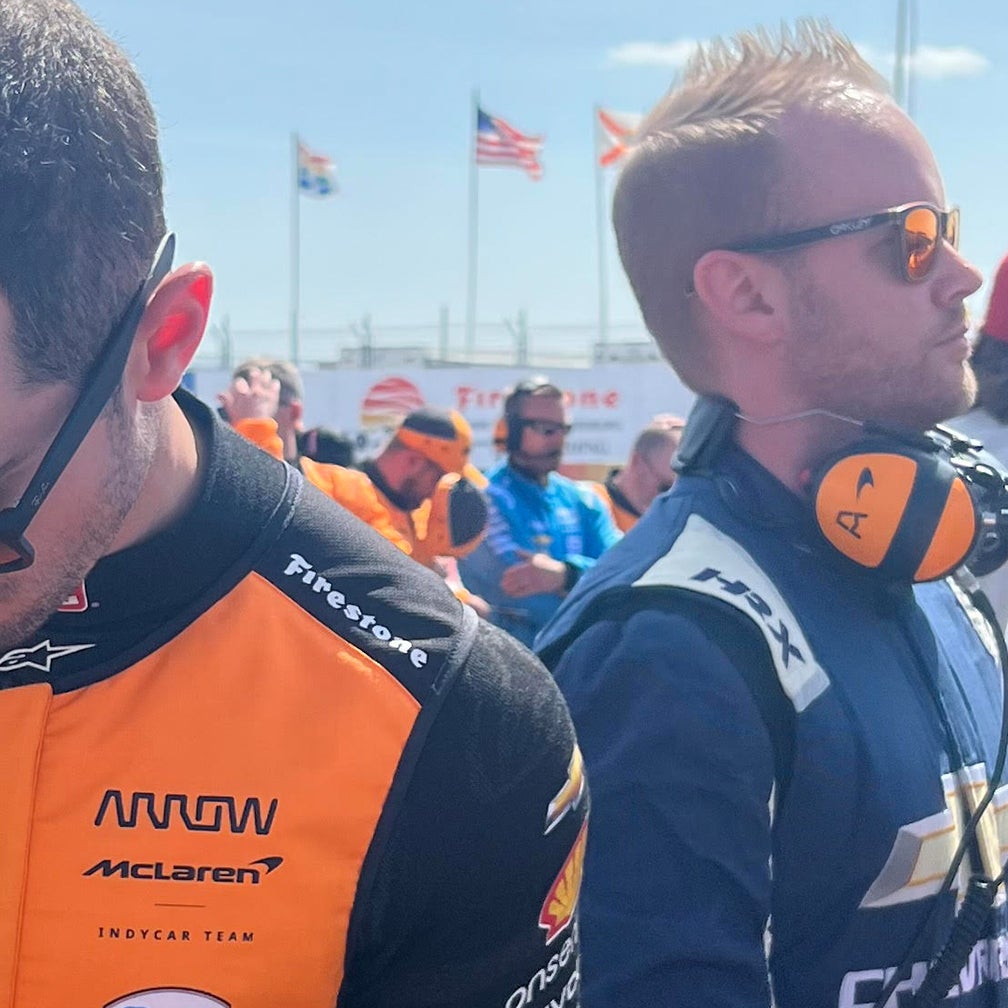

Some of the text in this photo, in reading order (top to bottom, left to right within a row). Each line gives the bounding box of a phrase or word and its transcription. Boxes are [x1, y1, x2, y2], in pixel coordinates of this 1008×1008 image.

[455, 385, 619, 409] Firone
[283, 553, 429, 668] Firestone
[689, 567, 806, 669] HRX
[95, 790, 279, 835] ARROW
[82, 859, 283, 884] McLaren
[98, 927, 255, 943] INDYCAR TEAM
